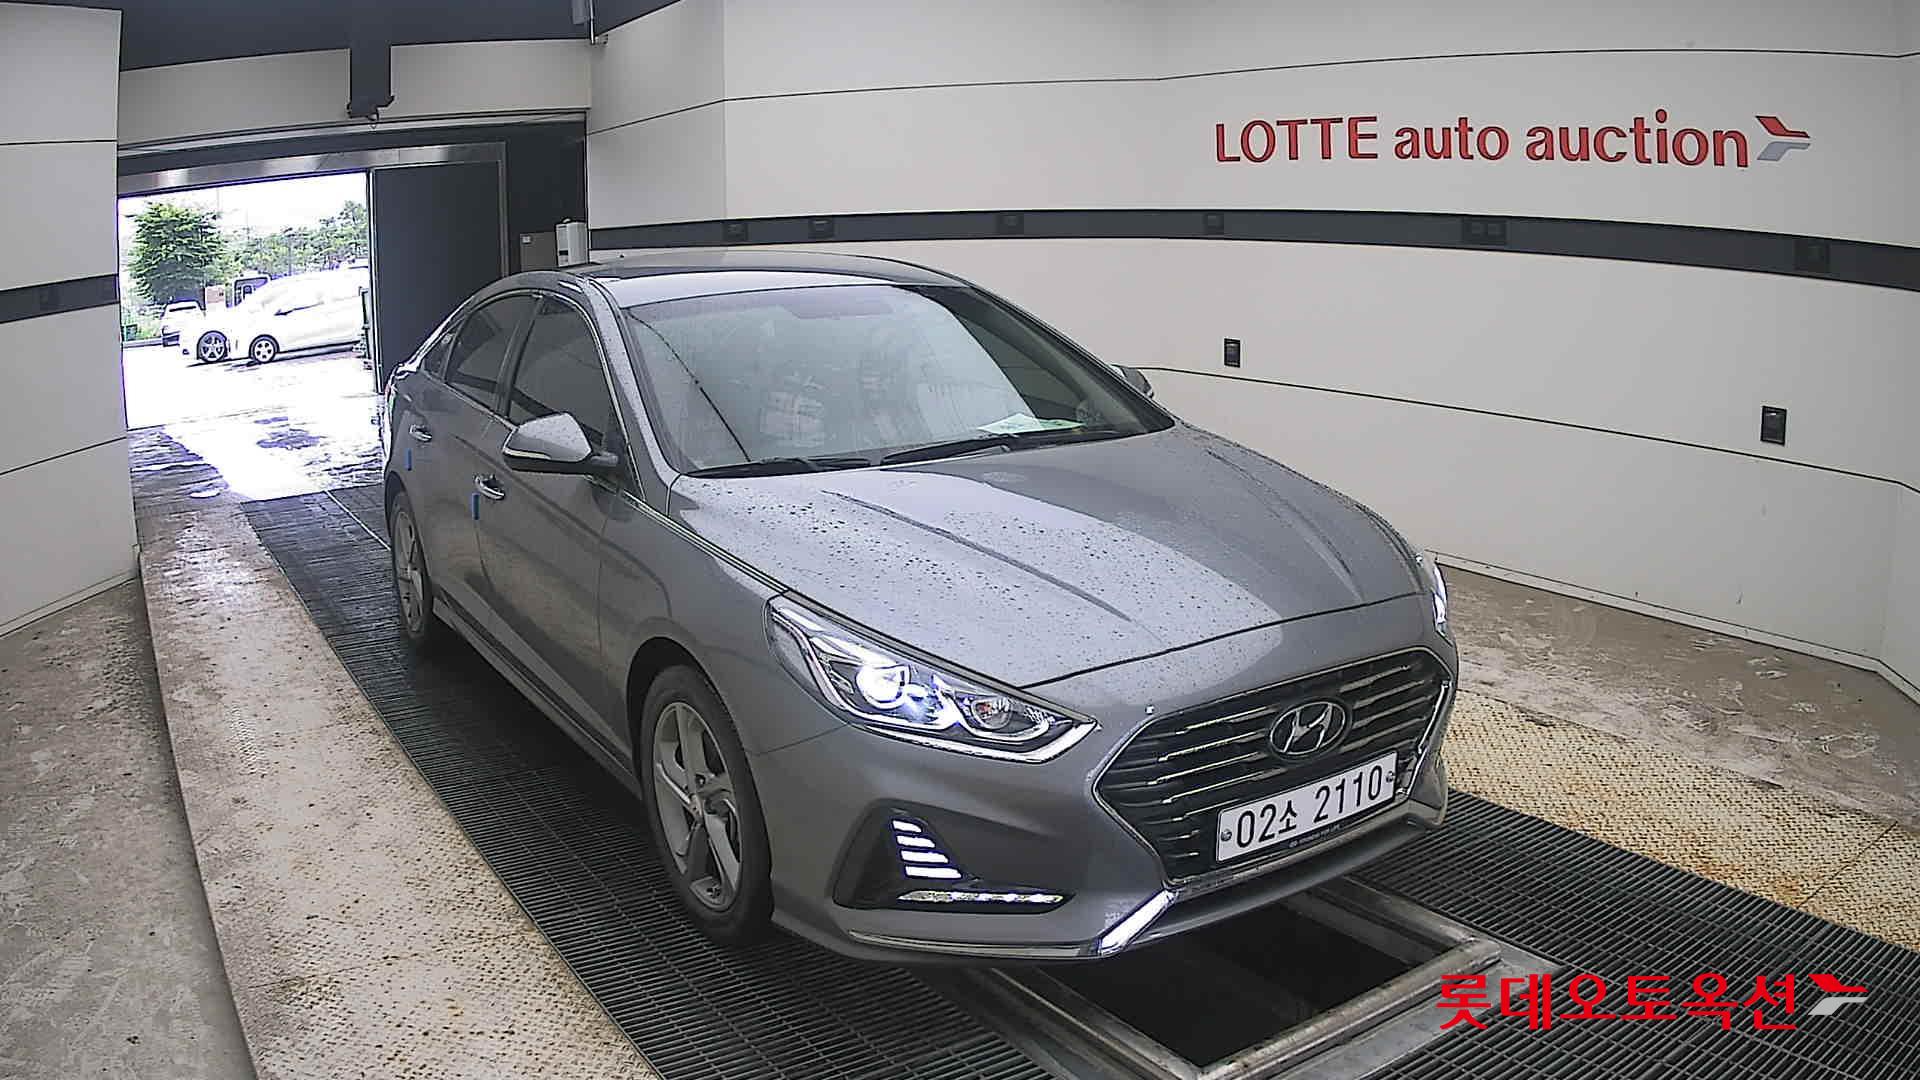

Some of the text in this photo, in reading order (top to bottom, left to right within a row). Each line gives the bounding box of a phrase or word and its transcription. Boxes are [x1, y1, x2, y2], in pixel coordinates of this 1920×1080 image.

[1216, 109, 1749, 168] LOTTE auto auction
[1236, 800, 1297, 848] 02소
[1313, 765, 1383, 823] 2110
